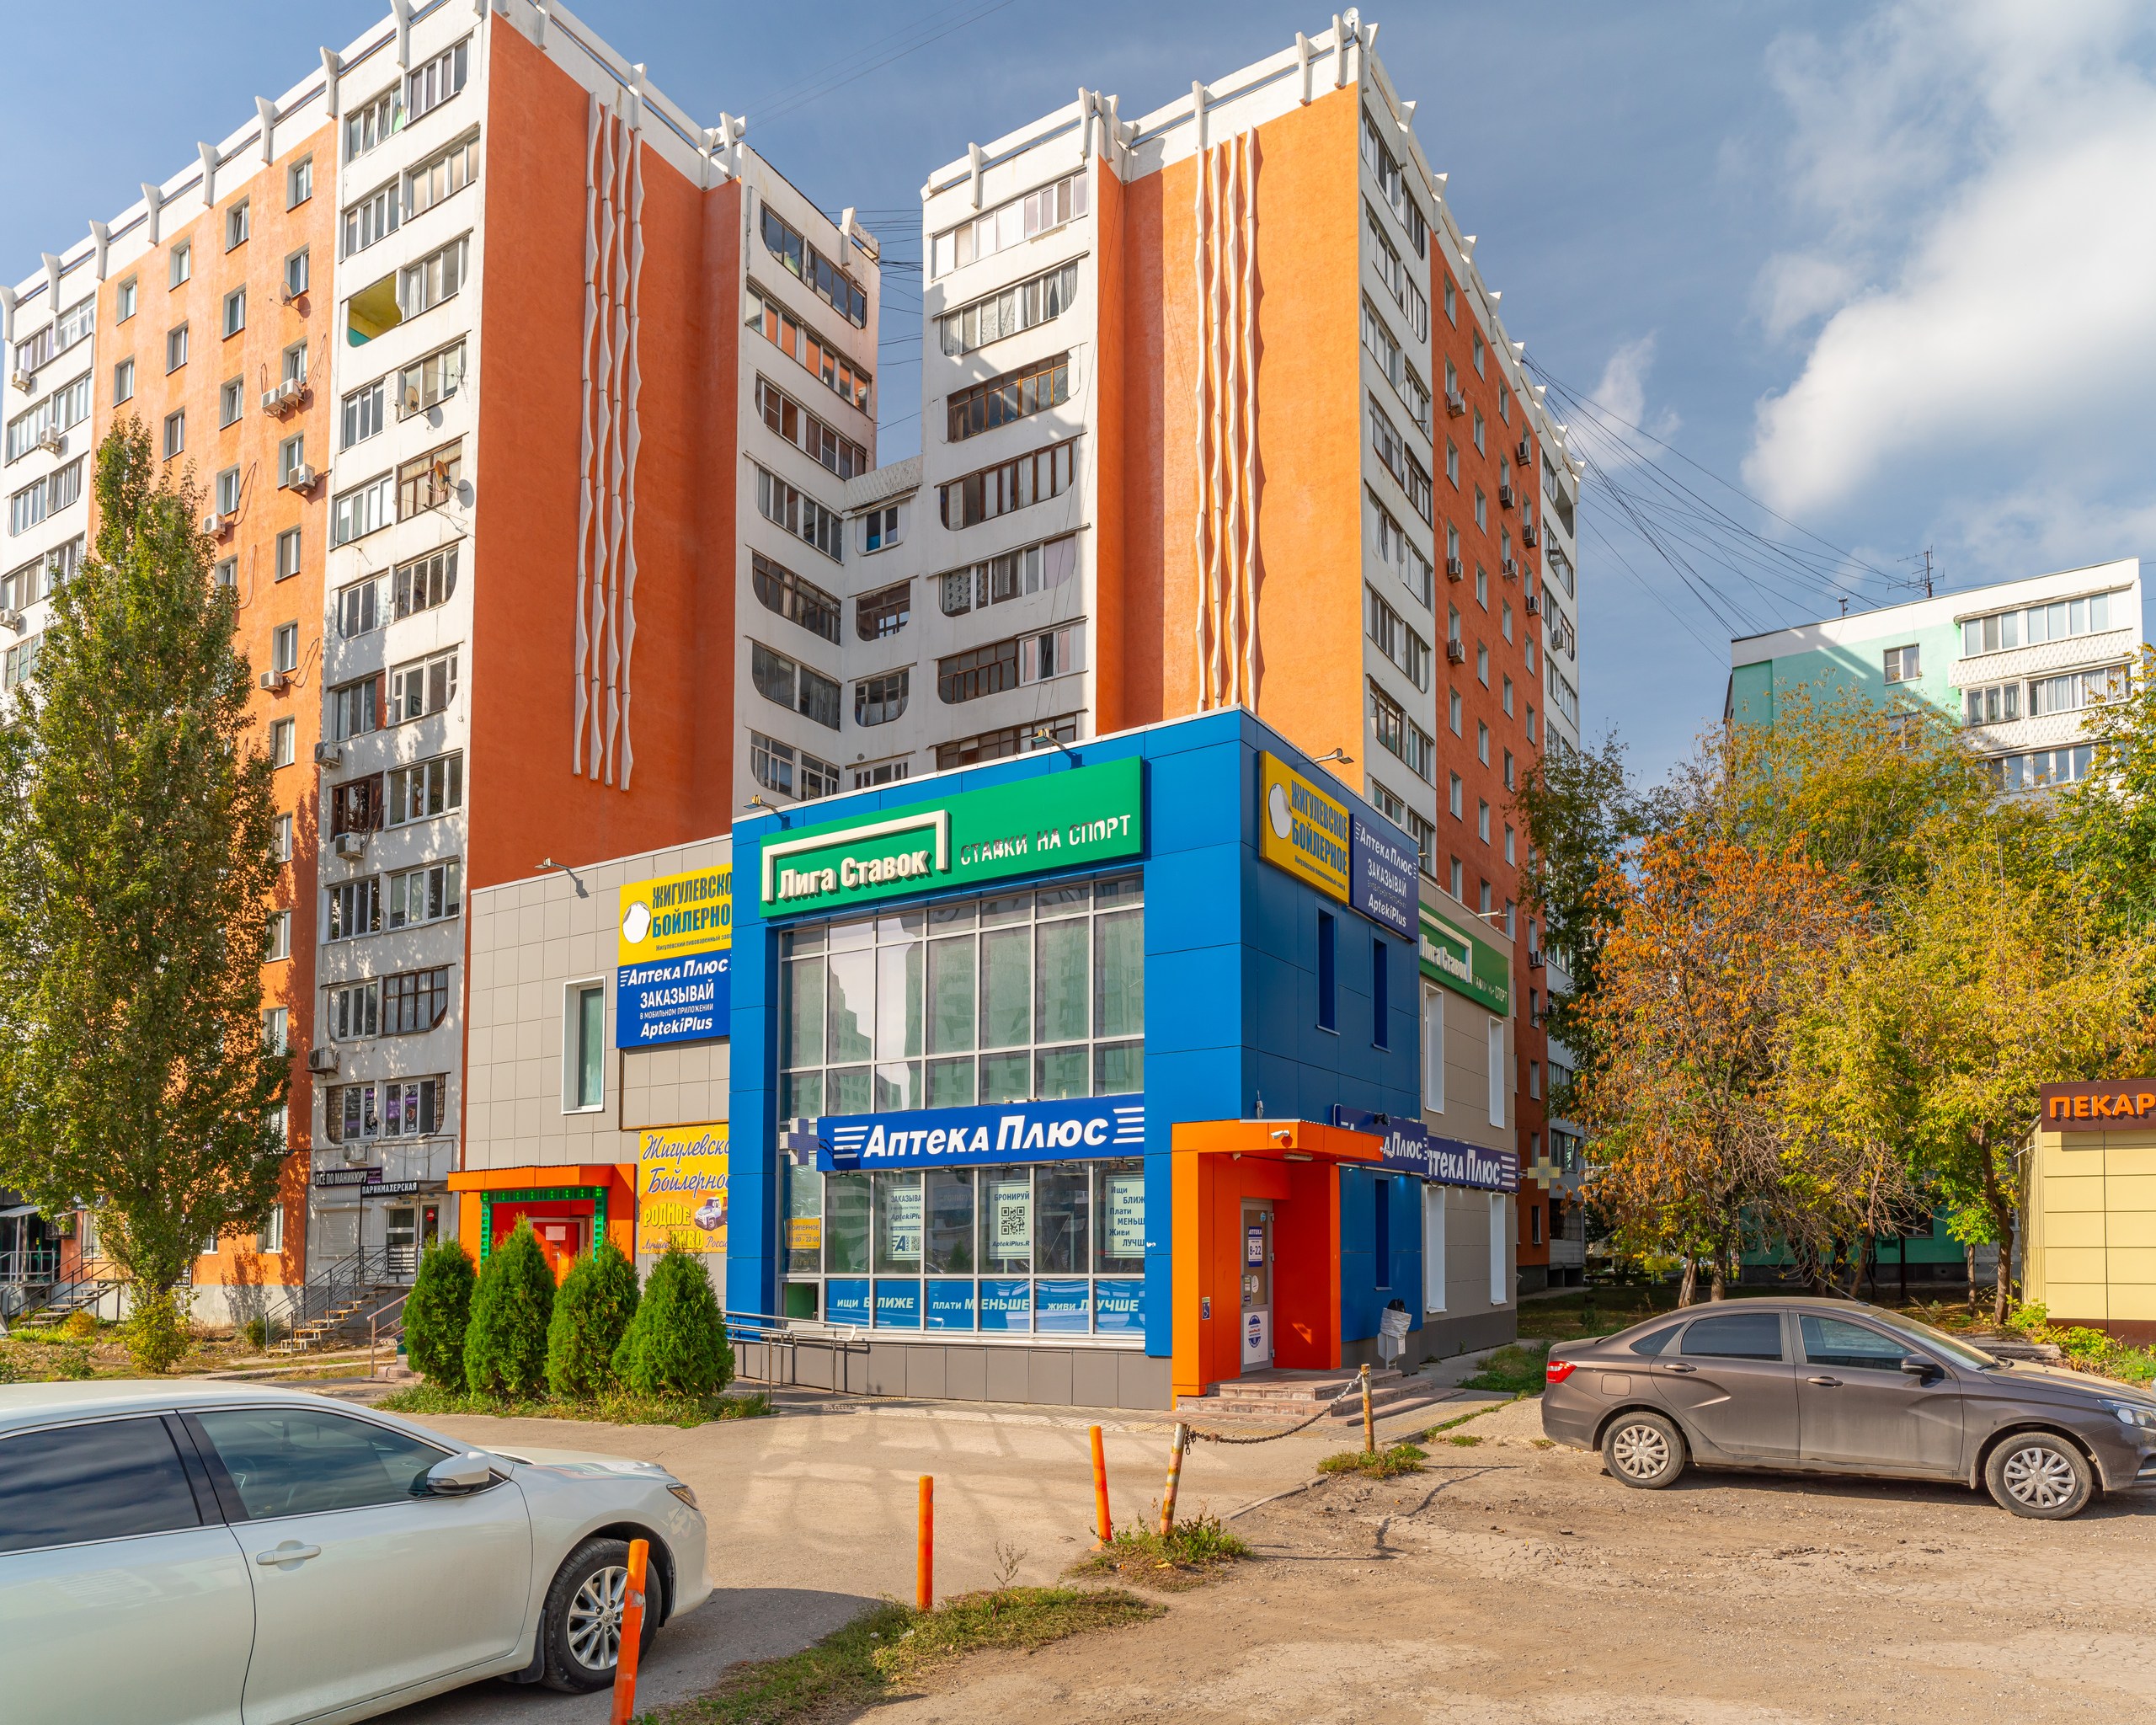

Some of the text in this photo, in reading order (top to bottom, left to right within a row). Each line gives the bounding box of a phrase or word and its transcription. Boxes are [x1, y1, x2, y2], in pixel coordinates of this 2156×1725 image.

[1291, 779, 1347, 842] ЖИГУЛЕВСКОЕ
[960, 814, 1131, 866] СТАВКИ НА СПОРТ
[1291, 817, 1347, 876] БОЙЛЕРНОЕ
[1360, 826, 1412, 876] Аптека Плюс
[778, 850, 929, 899] Лига Ставок
[1368, 858, 1406, 898] ЗАКАЗЫВАЙ
[652, 903, 731, 937] БОЙЛЕРНО
[1368, 894, 1406, 927] AptekiPlus
[1420, 934, 1467, 981] Лига Ставок
[627, 959, 728, 986] Аптека Плюс
[640, 979, 714, 1008] ЗАКАЗЫВАЙ
[677, 1003, 713, 1015] ПРИЛОЖЕНИИ
[640, 1017, 712, 1039] AptekiPlus
[2049, 1092, 2156, 1119] ПЕКАР
[863, 1115, 1107, 1157] Аптека Плюс
[1392, 1131, 1422, 1160] Плюс
[326, 1172, 334, 1184] ПО
[336, 1171, 367, 1184] МАНИКЮРУ
[1428, 1149, 1500, 1185] птека Плюс
[361, 1182, 418, 1194] ПАРИКМАХЕРСКАЯ
[994, 1191, 1030, 1201] БРОНИРУЙ
[643, 1202, 691, 1229] РОДНОЕ
[1249, 1246, 1262, 1255] 8-22
[932, 1301, 962, 1310] ПЛАТИ
